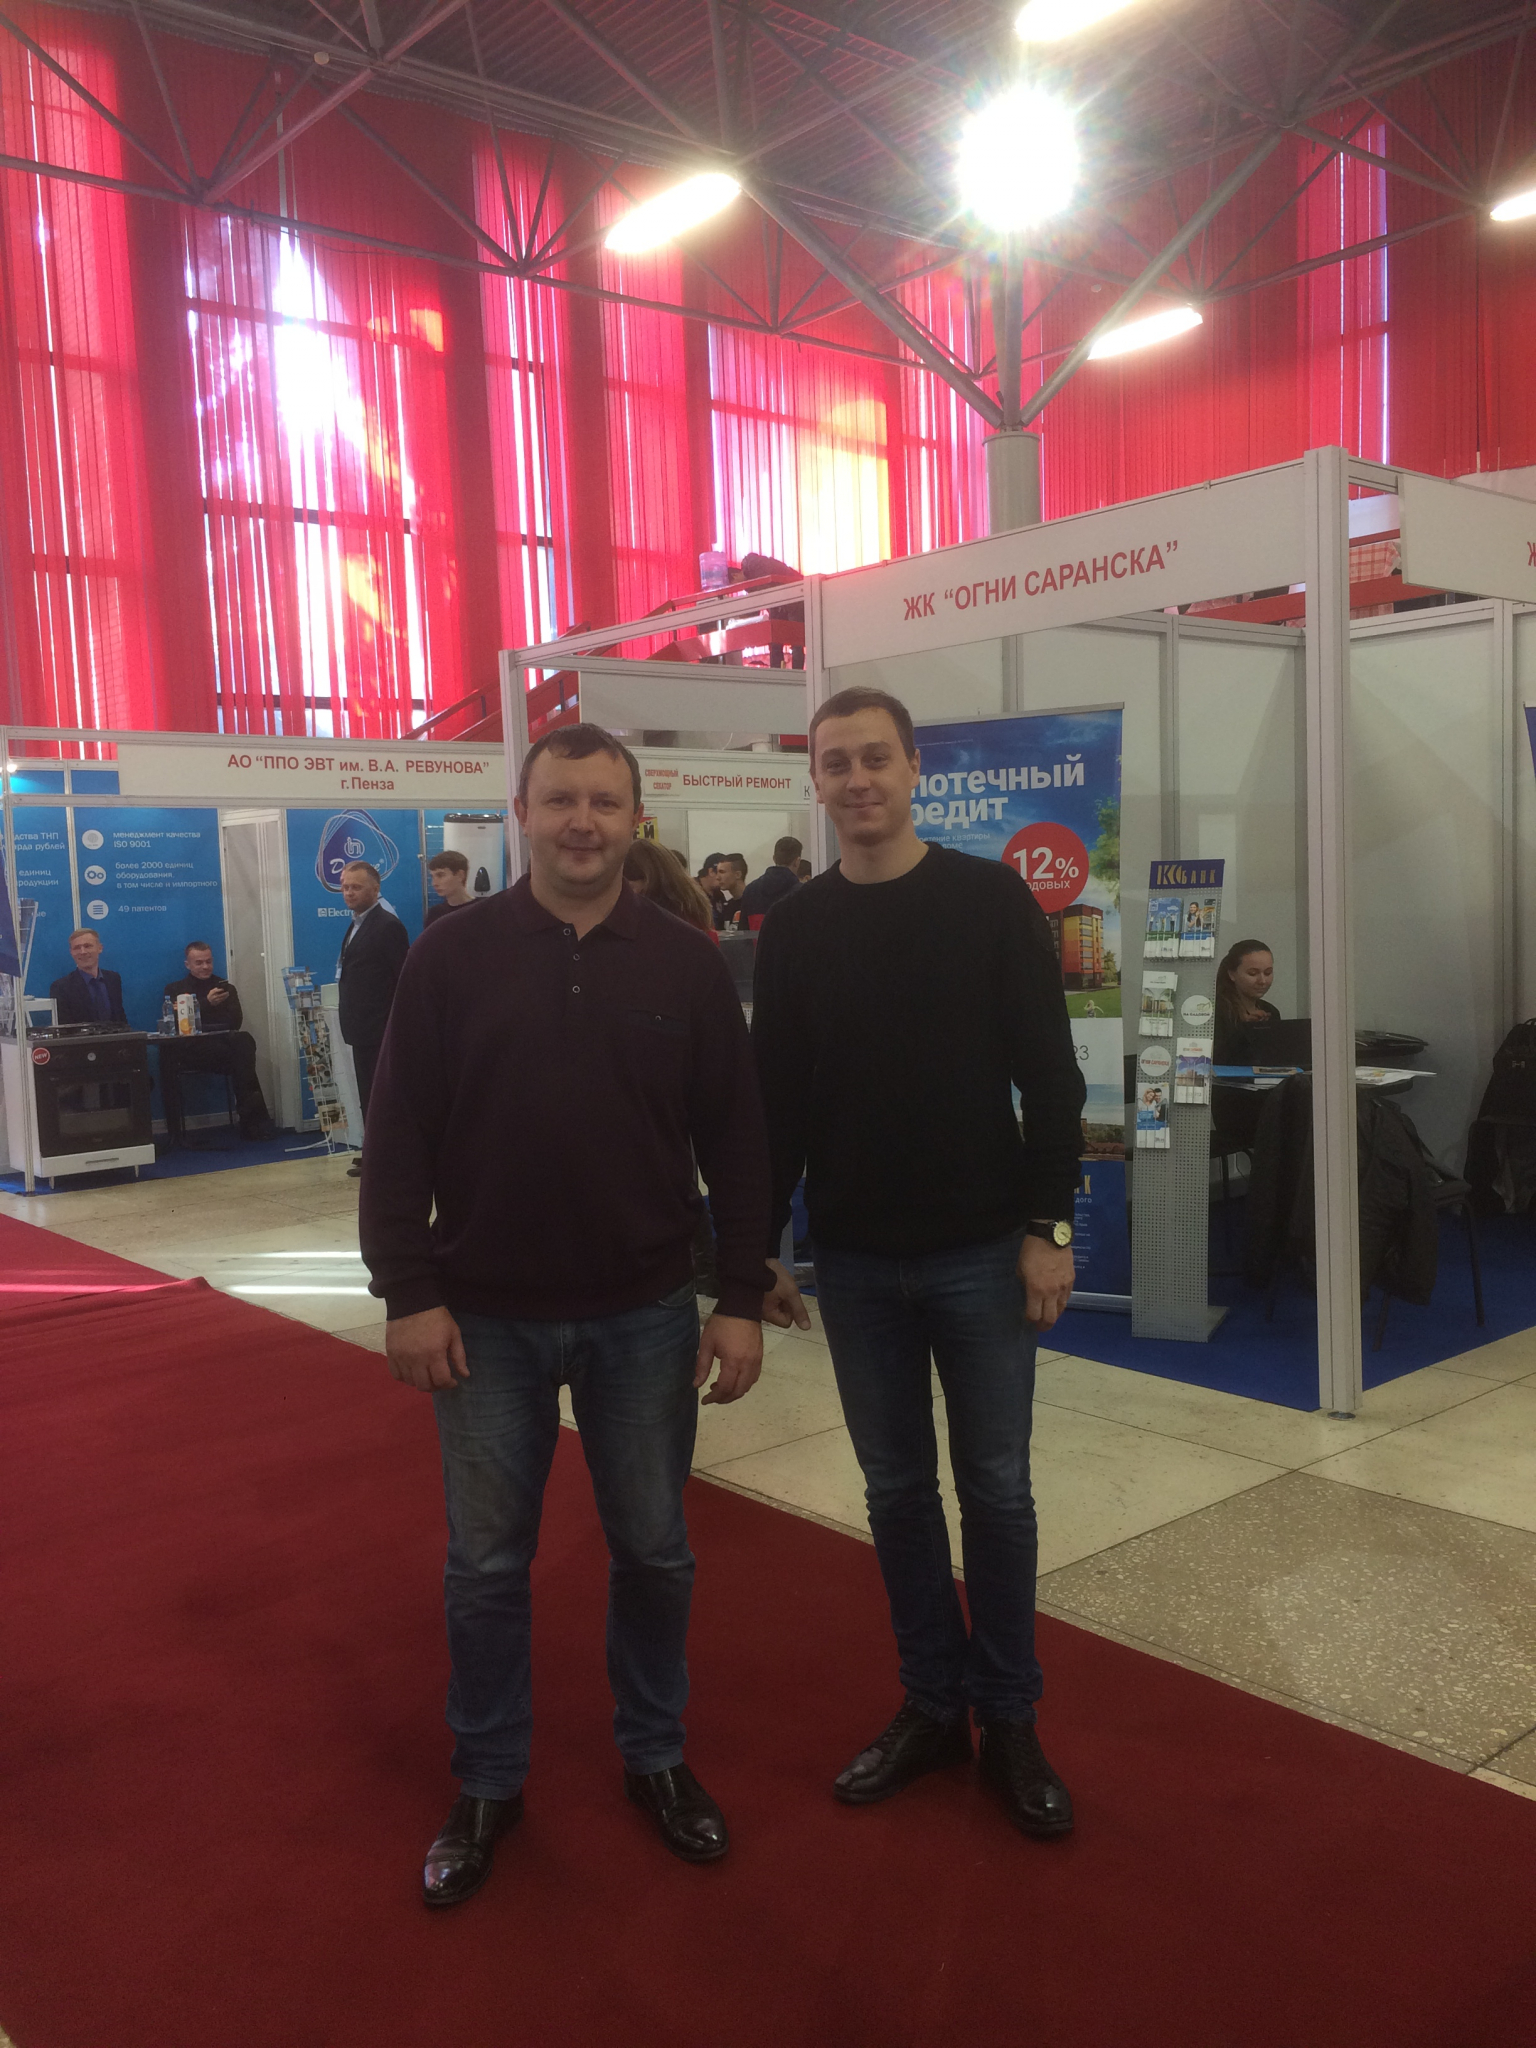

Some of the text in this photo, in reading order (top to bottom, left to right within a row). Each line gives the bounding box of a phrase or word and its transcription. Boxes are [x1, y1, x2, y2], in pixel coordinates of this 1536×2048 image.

[903, 592, 935, 621] ЖК
[227, 754, 252, 769] АО
[304, 757, 335, 772] ЭВТ
[339, 761, 364, 772] им.
[683, 773, 791, 789] БЫСТРЫЙ РЕМОНТ
[911, 753, 1085, 798] потечный
[652, 782, 672, 791] СЕКАТОР
[910, 797, 1009, 830] редит
[1013, 846, 1079, 880] 12%
[18, 880, 59, 888] родукции
[328, 907, 354, 917] Electr
